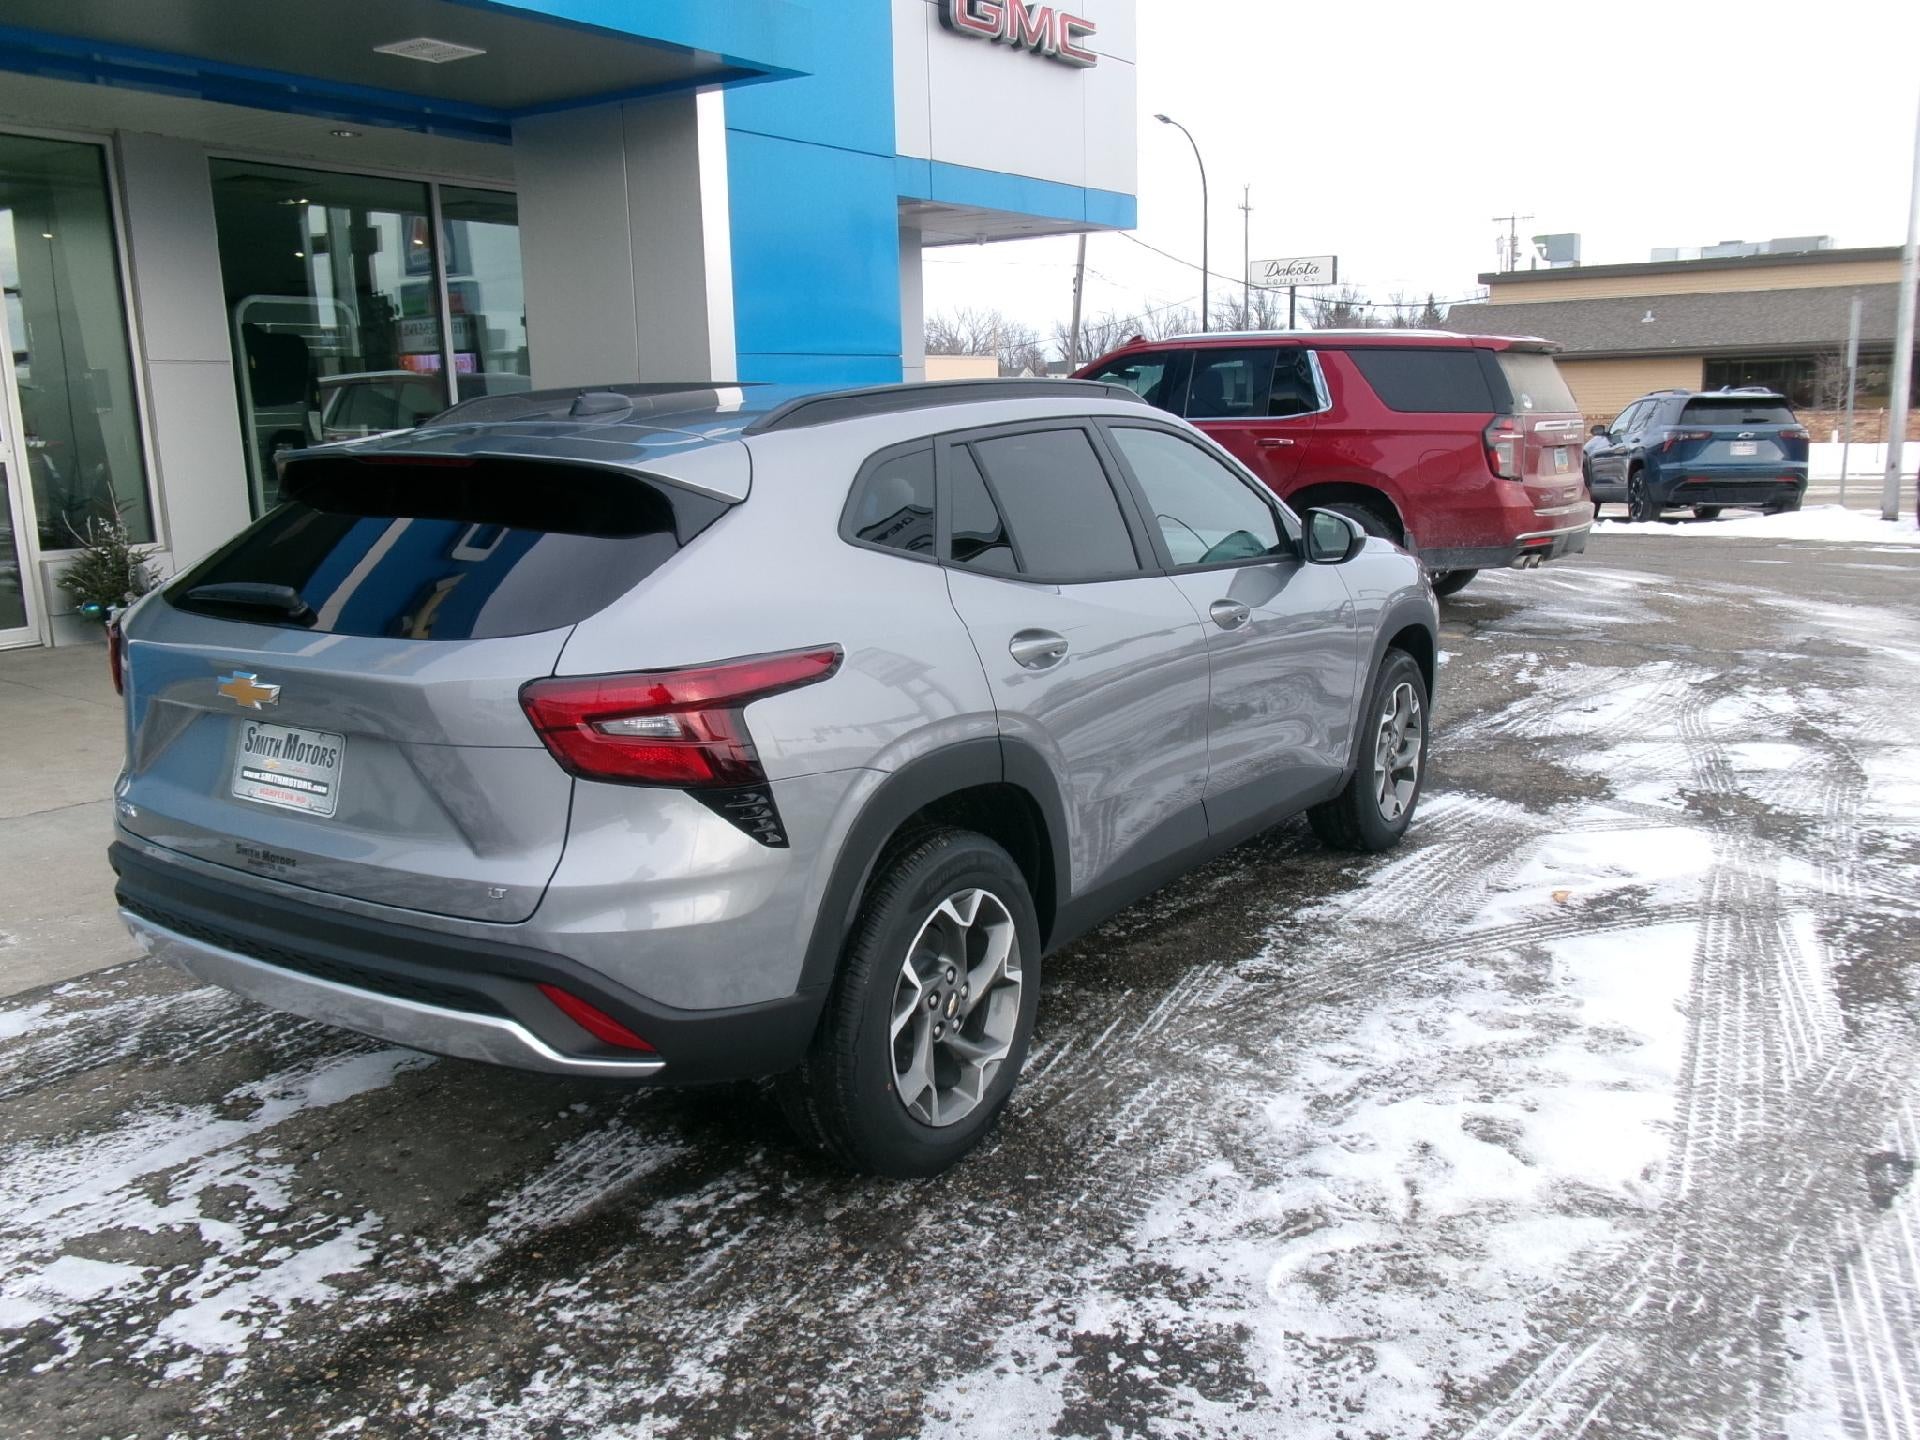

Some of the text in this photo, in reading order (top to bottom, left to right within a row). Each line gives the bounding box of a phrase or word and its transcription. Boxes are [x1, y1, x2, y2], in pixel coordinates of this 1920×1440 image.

[943, 0, 1098, 67] GMC
[1264, 260, 1321, 277] Dakota
[244, 726, 338, 769] SMITH MOTORS
[487, 886, 508, 899] LT
